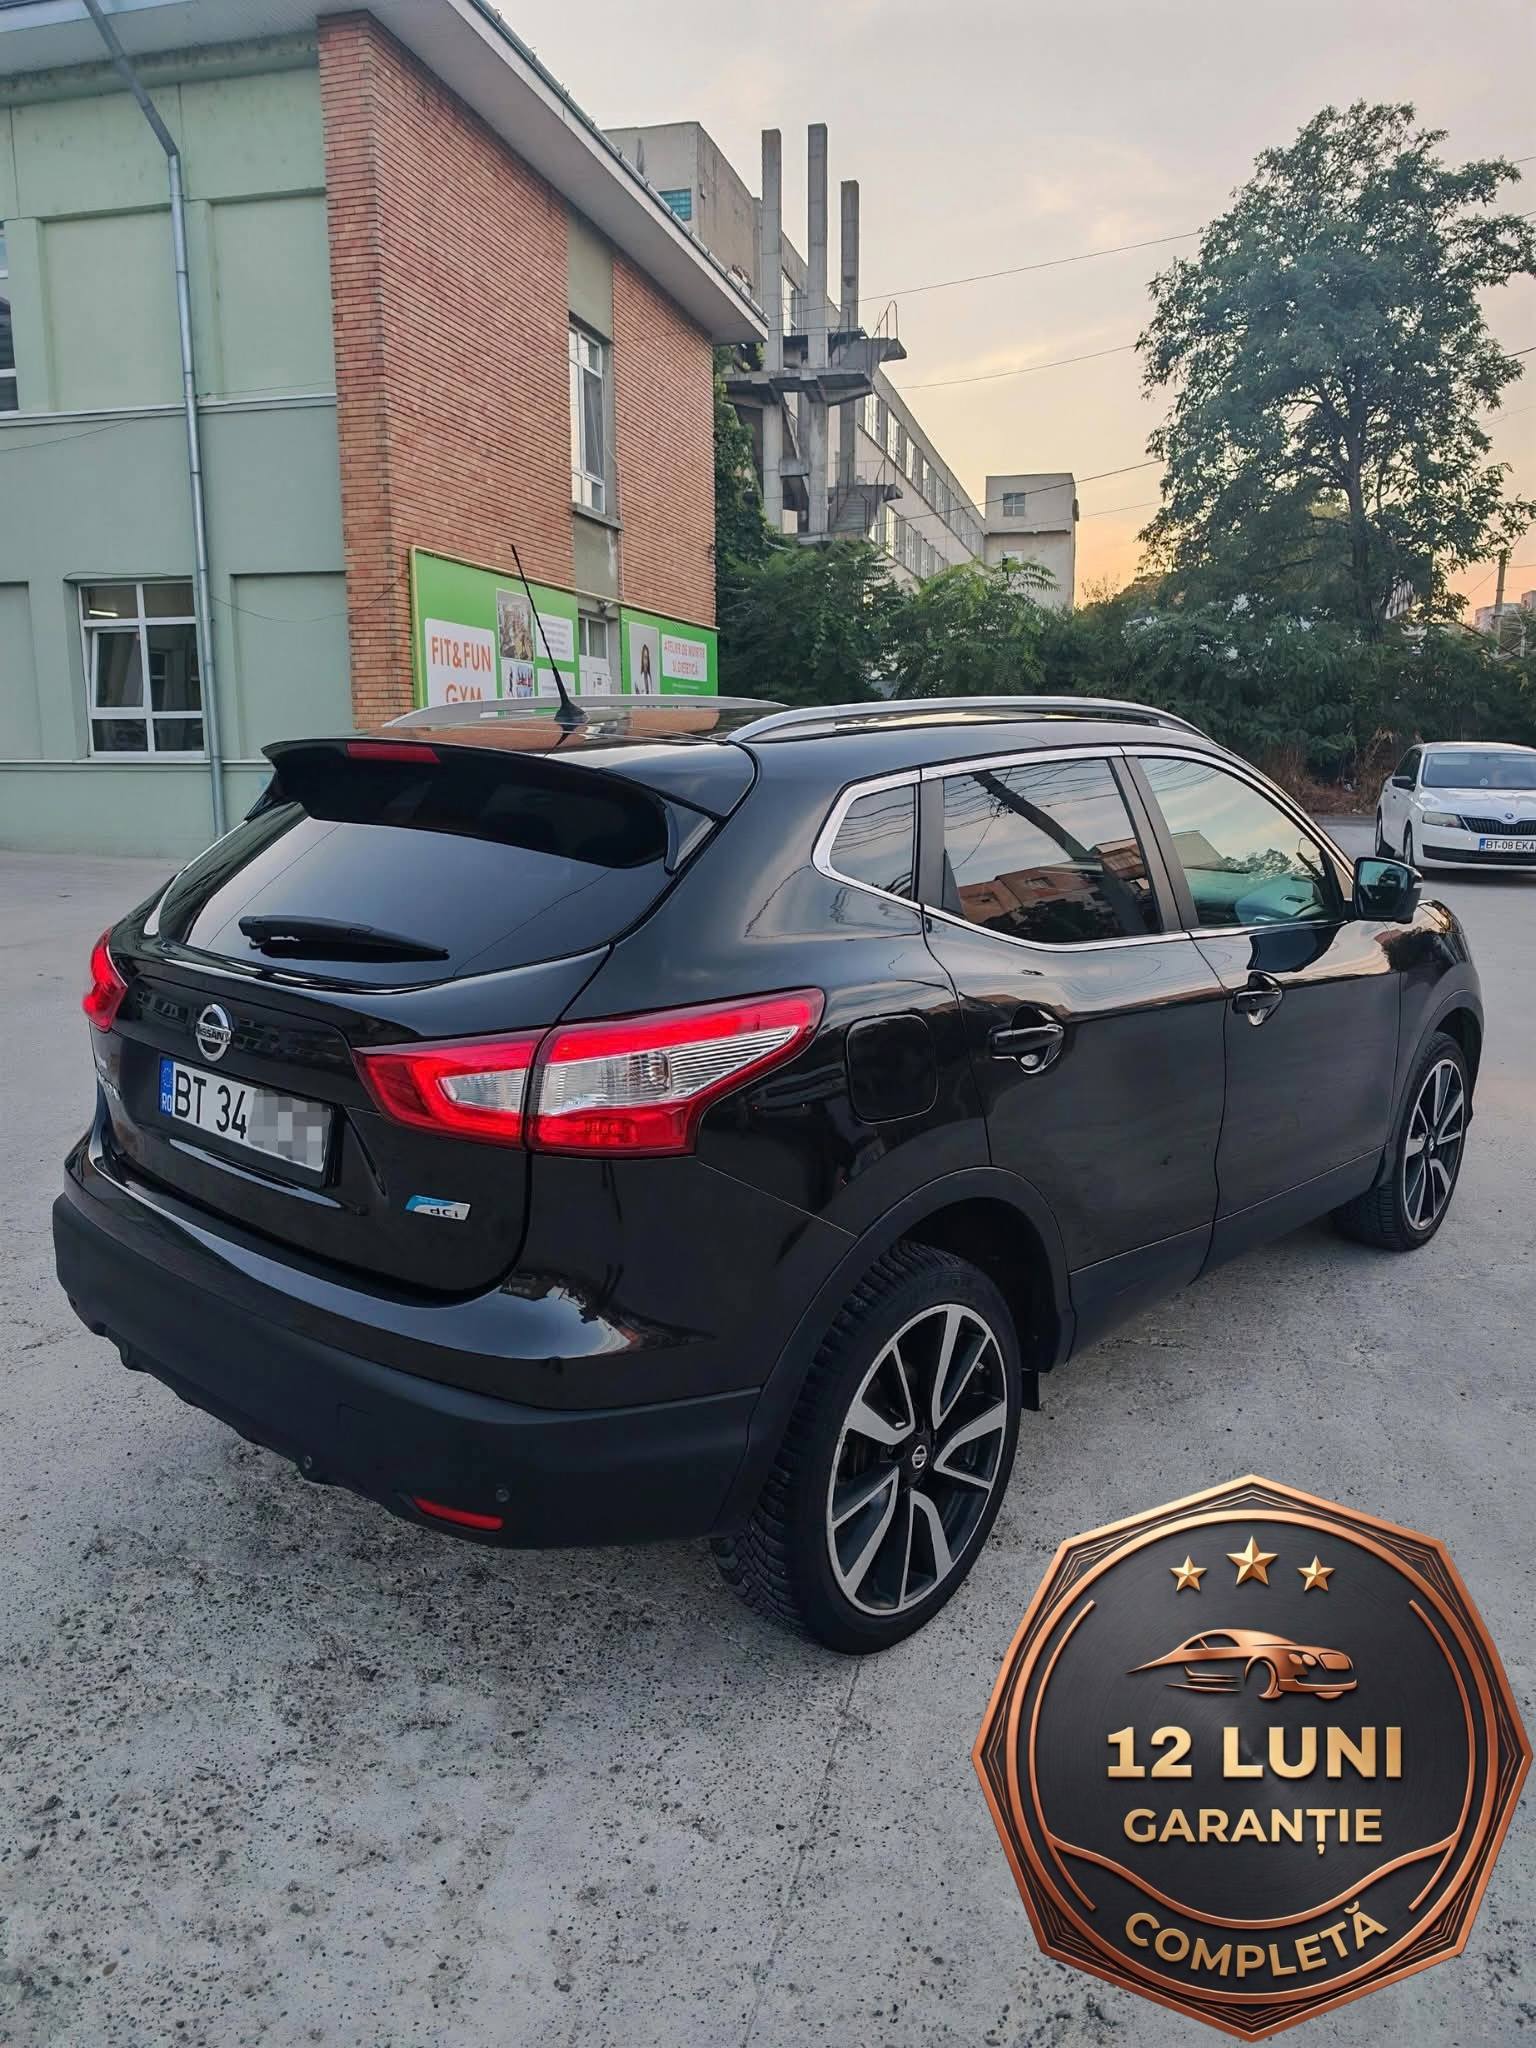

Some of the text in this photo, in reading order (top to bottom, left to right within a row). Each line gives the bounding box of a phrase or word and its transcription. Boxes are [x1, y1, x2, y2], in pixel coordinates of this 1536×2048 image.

[431, 635, 491, 672] FIT&FUN
[161, 1092, 173, 1113] RO
[174, 1069, 207, 1124] BT
[216, 1084, 247, 1140] 34
